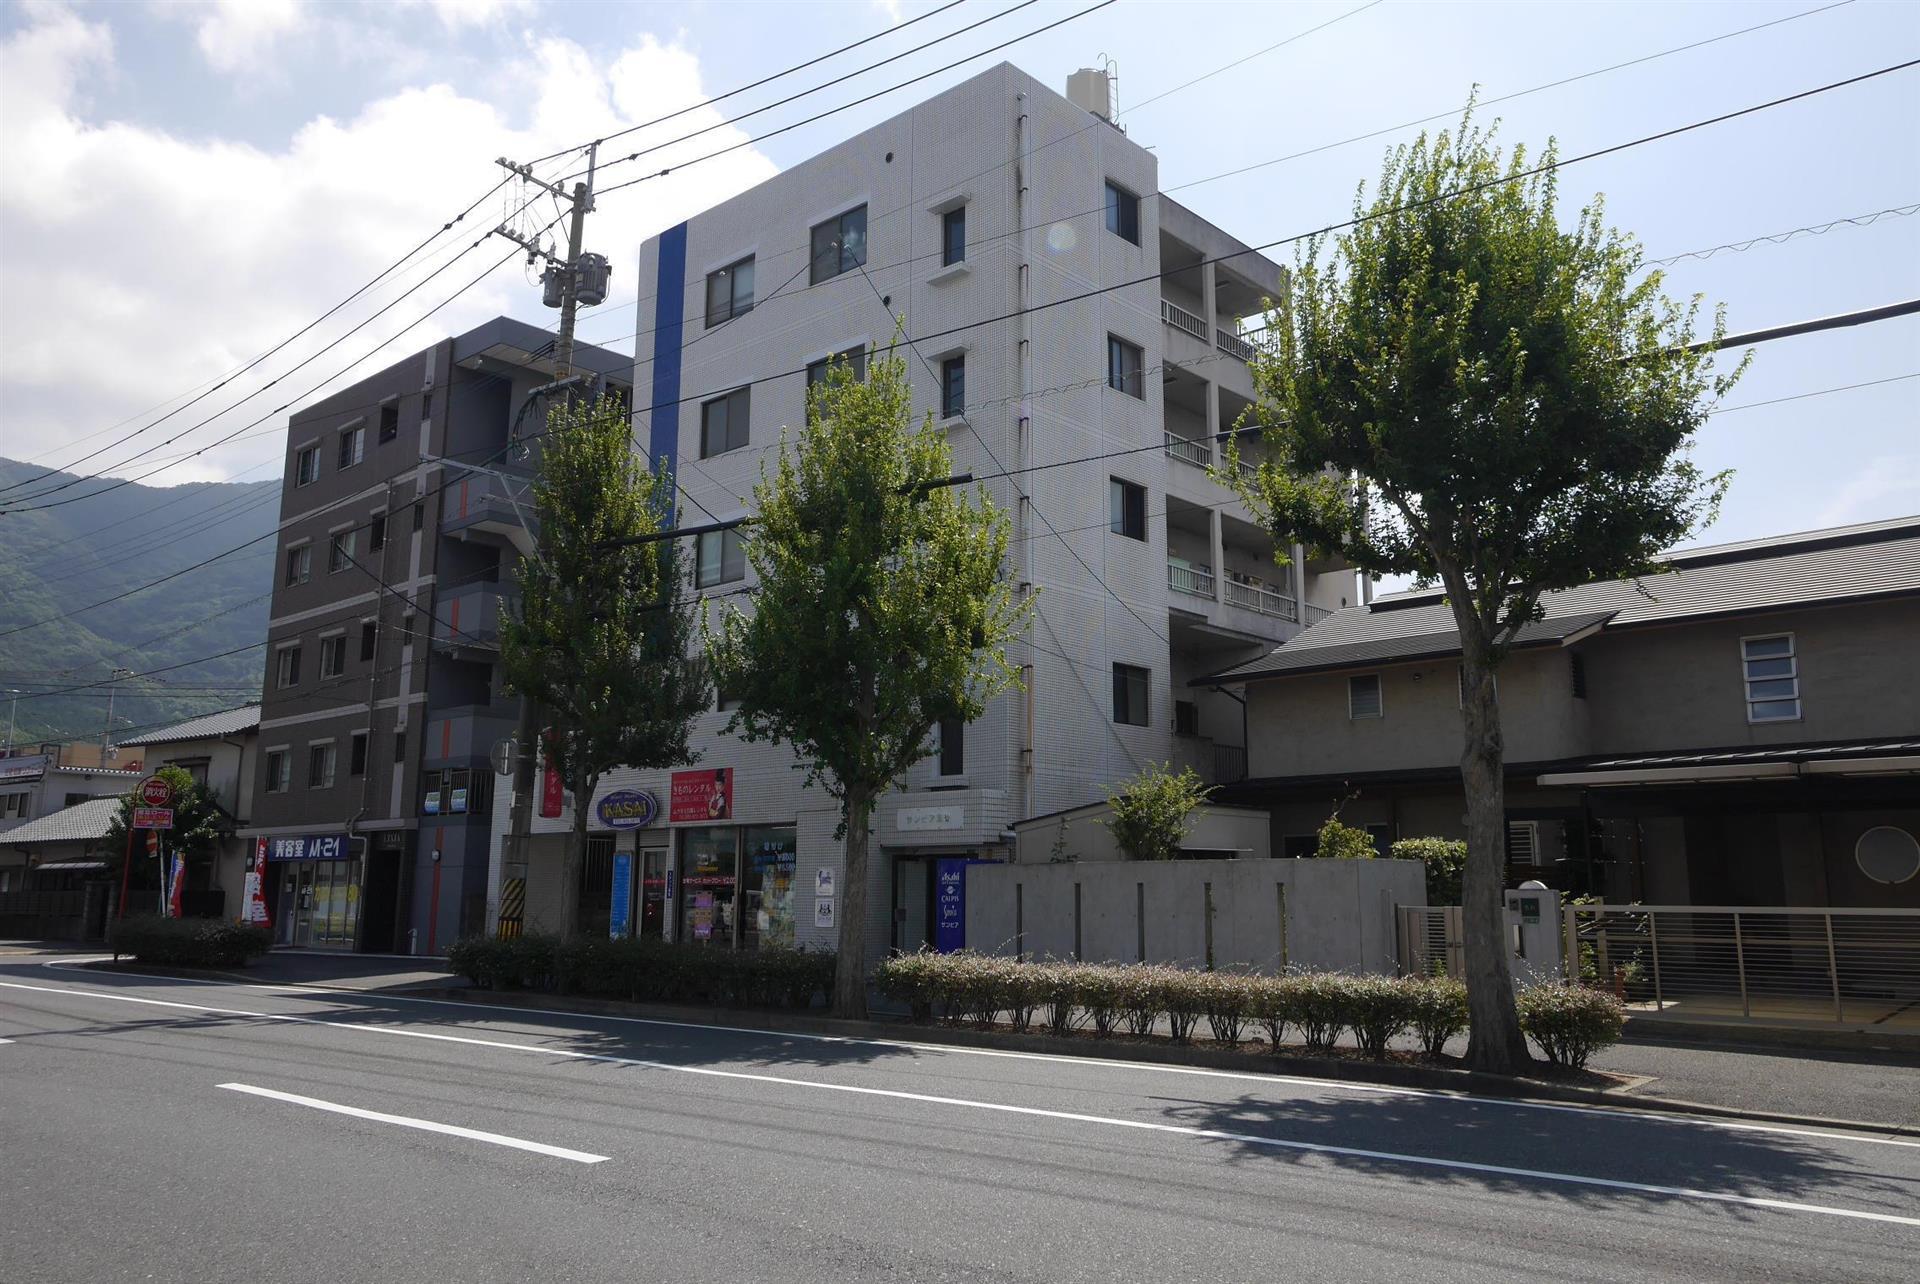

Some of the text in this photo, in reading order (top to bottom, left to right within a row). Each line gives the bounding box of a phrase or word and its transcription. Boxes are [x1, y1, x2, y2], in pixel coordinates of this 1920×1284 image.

[144, 787, 167, 798] 消火栓
[672, 784, 712, 796] きものレンタル
[603, 800, 647, 818] KASAI
[275, 839, 304, 858] 美容室
[941, 872, 960, 881] Asahi
[941, 895, 960, 904] CALPIS
